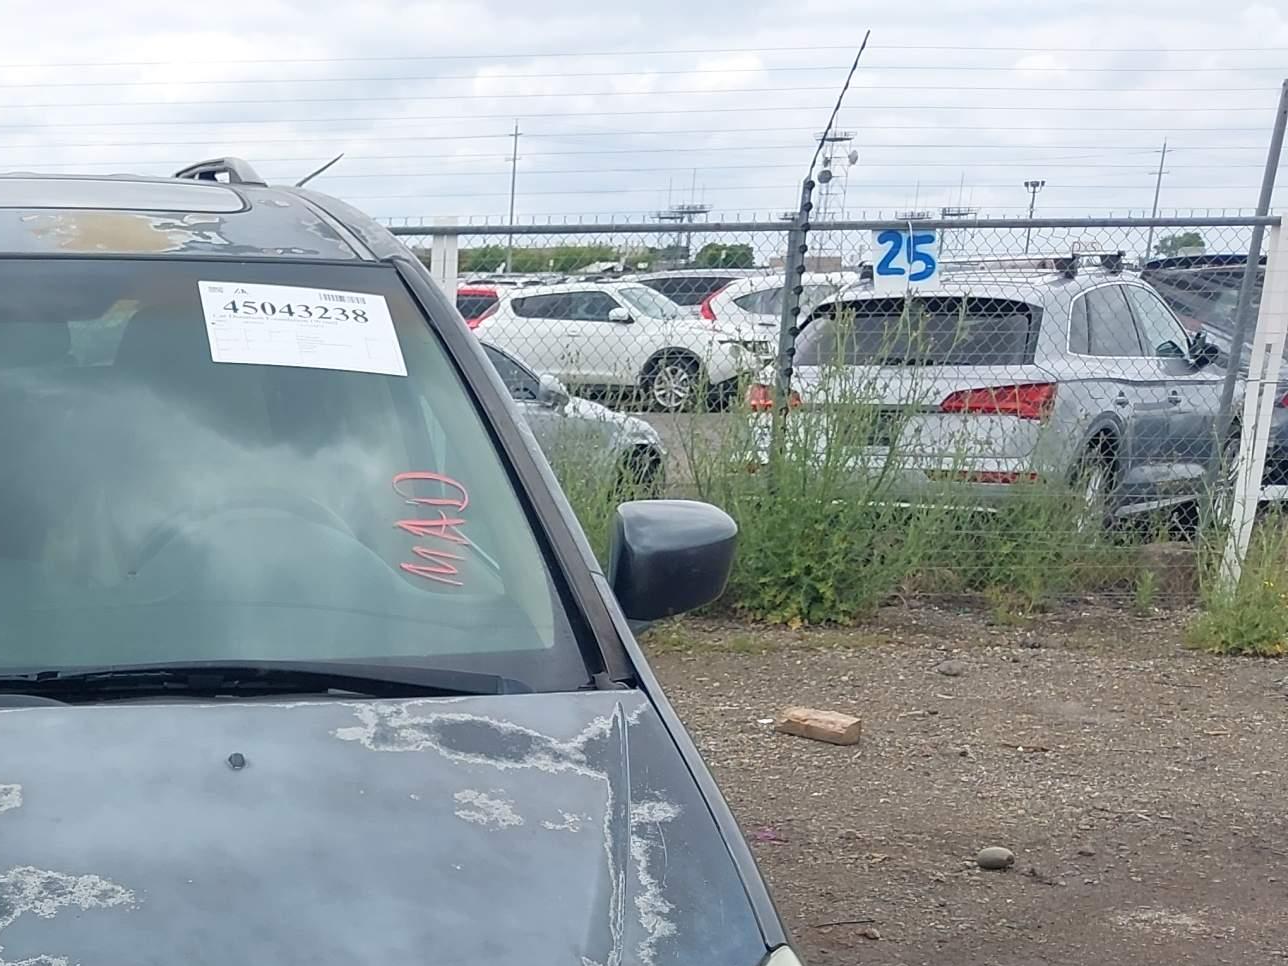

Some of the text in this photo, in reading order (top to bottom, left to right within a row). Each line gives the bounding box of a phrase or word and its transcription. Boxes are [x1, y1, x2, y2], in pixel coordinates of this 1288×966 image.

[877, 230, 936, 281] 25
[223, 300, 369, 323] 45043238
[392, 471, 469, 586] MAD
